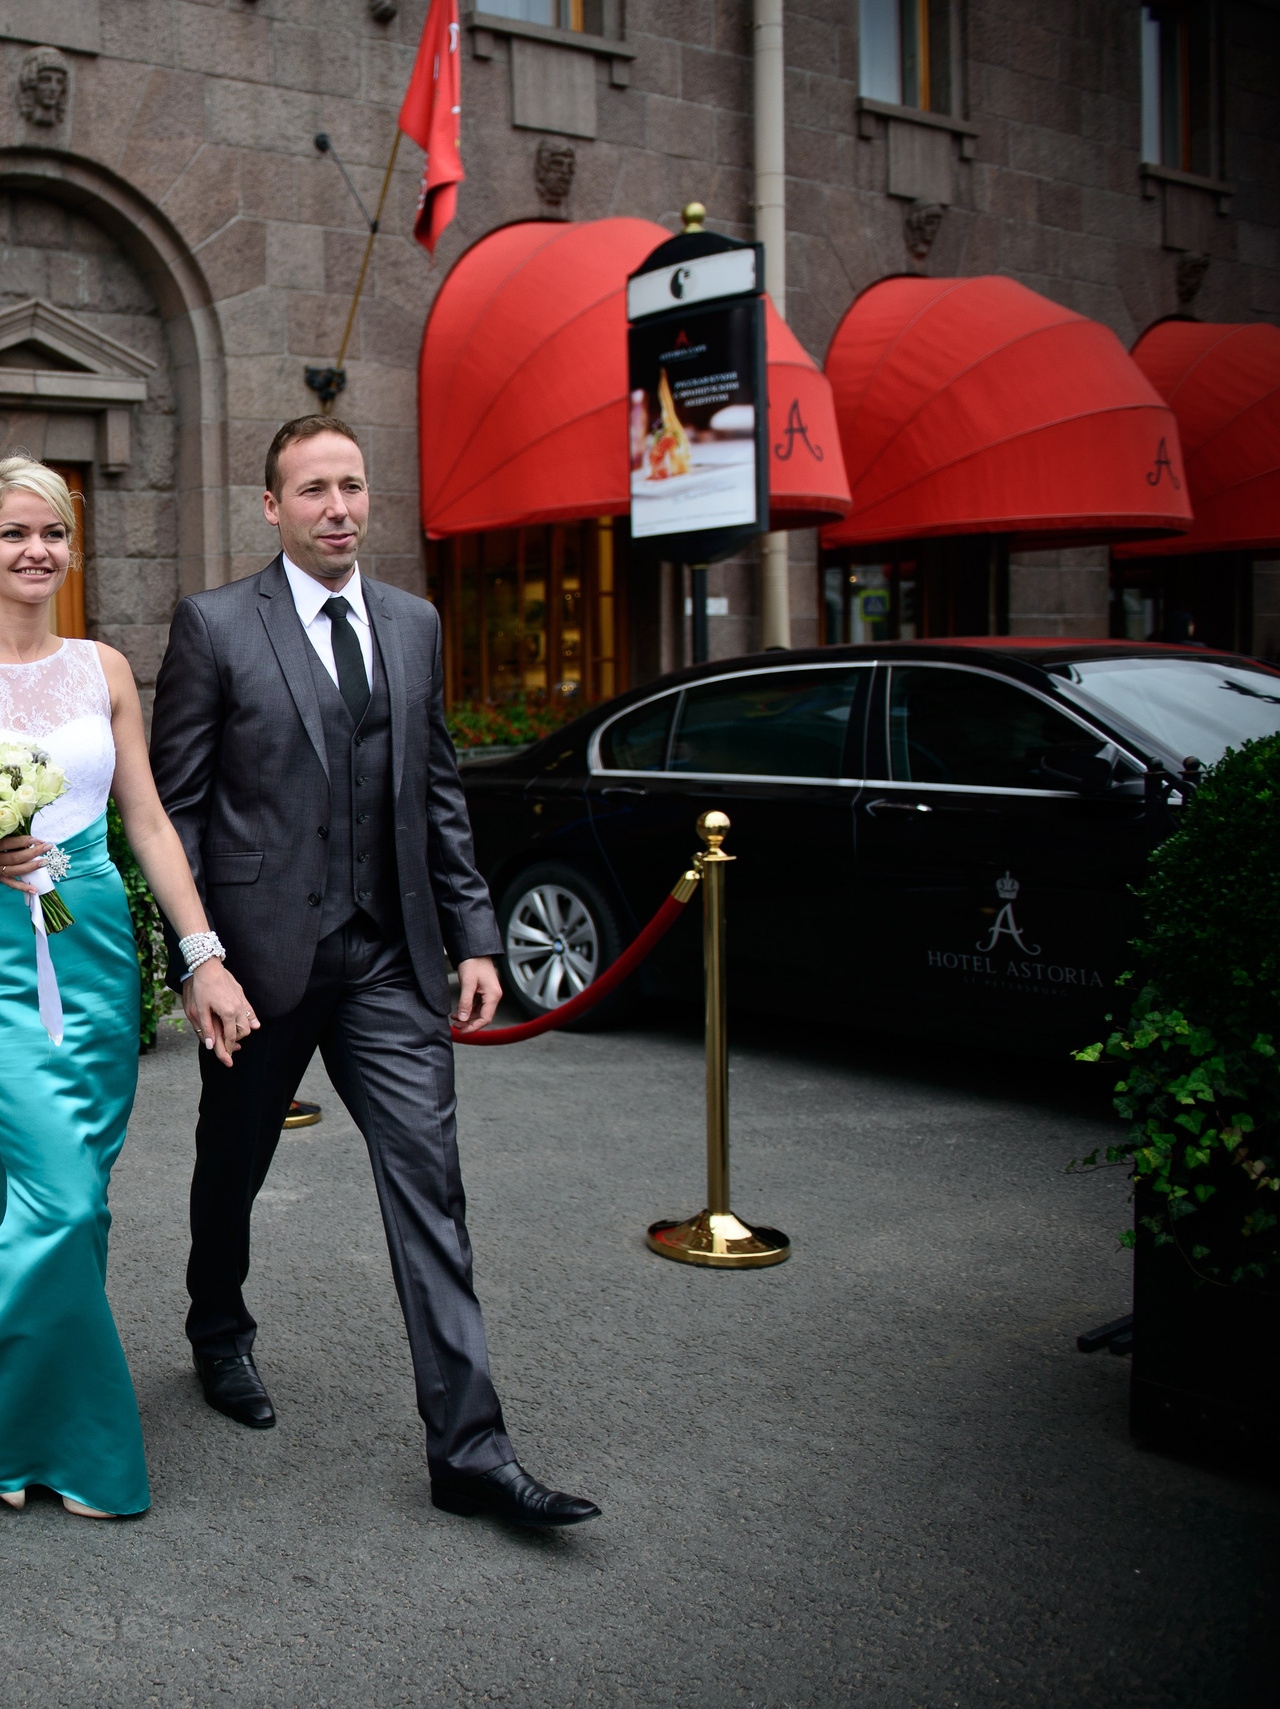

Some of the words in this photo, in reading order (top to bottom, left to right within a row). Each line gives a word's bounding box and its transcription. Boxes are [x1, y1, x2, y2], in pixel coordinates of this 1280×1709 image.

[774, 399, 823, 461] A
[1146, 436, 1181, 490] A
[975, 902, 1042, 956] A
[927, 949, 997, 974] HOTEL
[1006, 960, 1104, 988] ASTORIA
